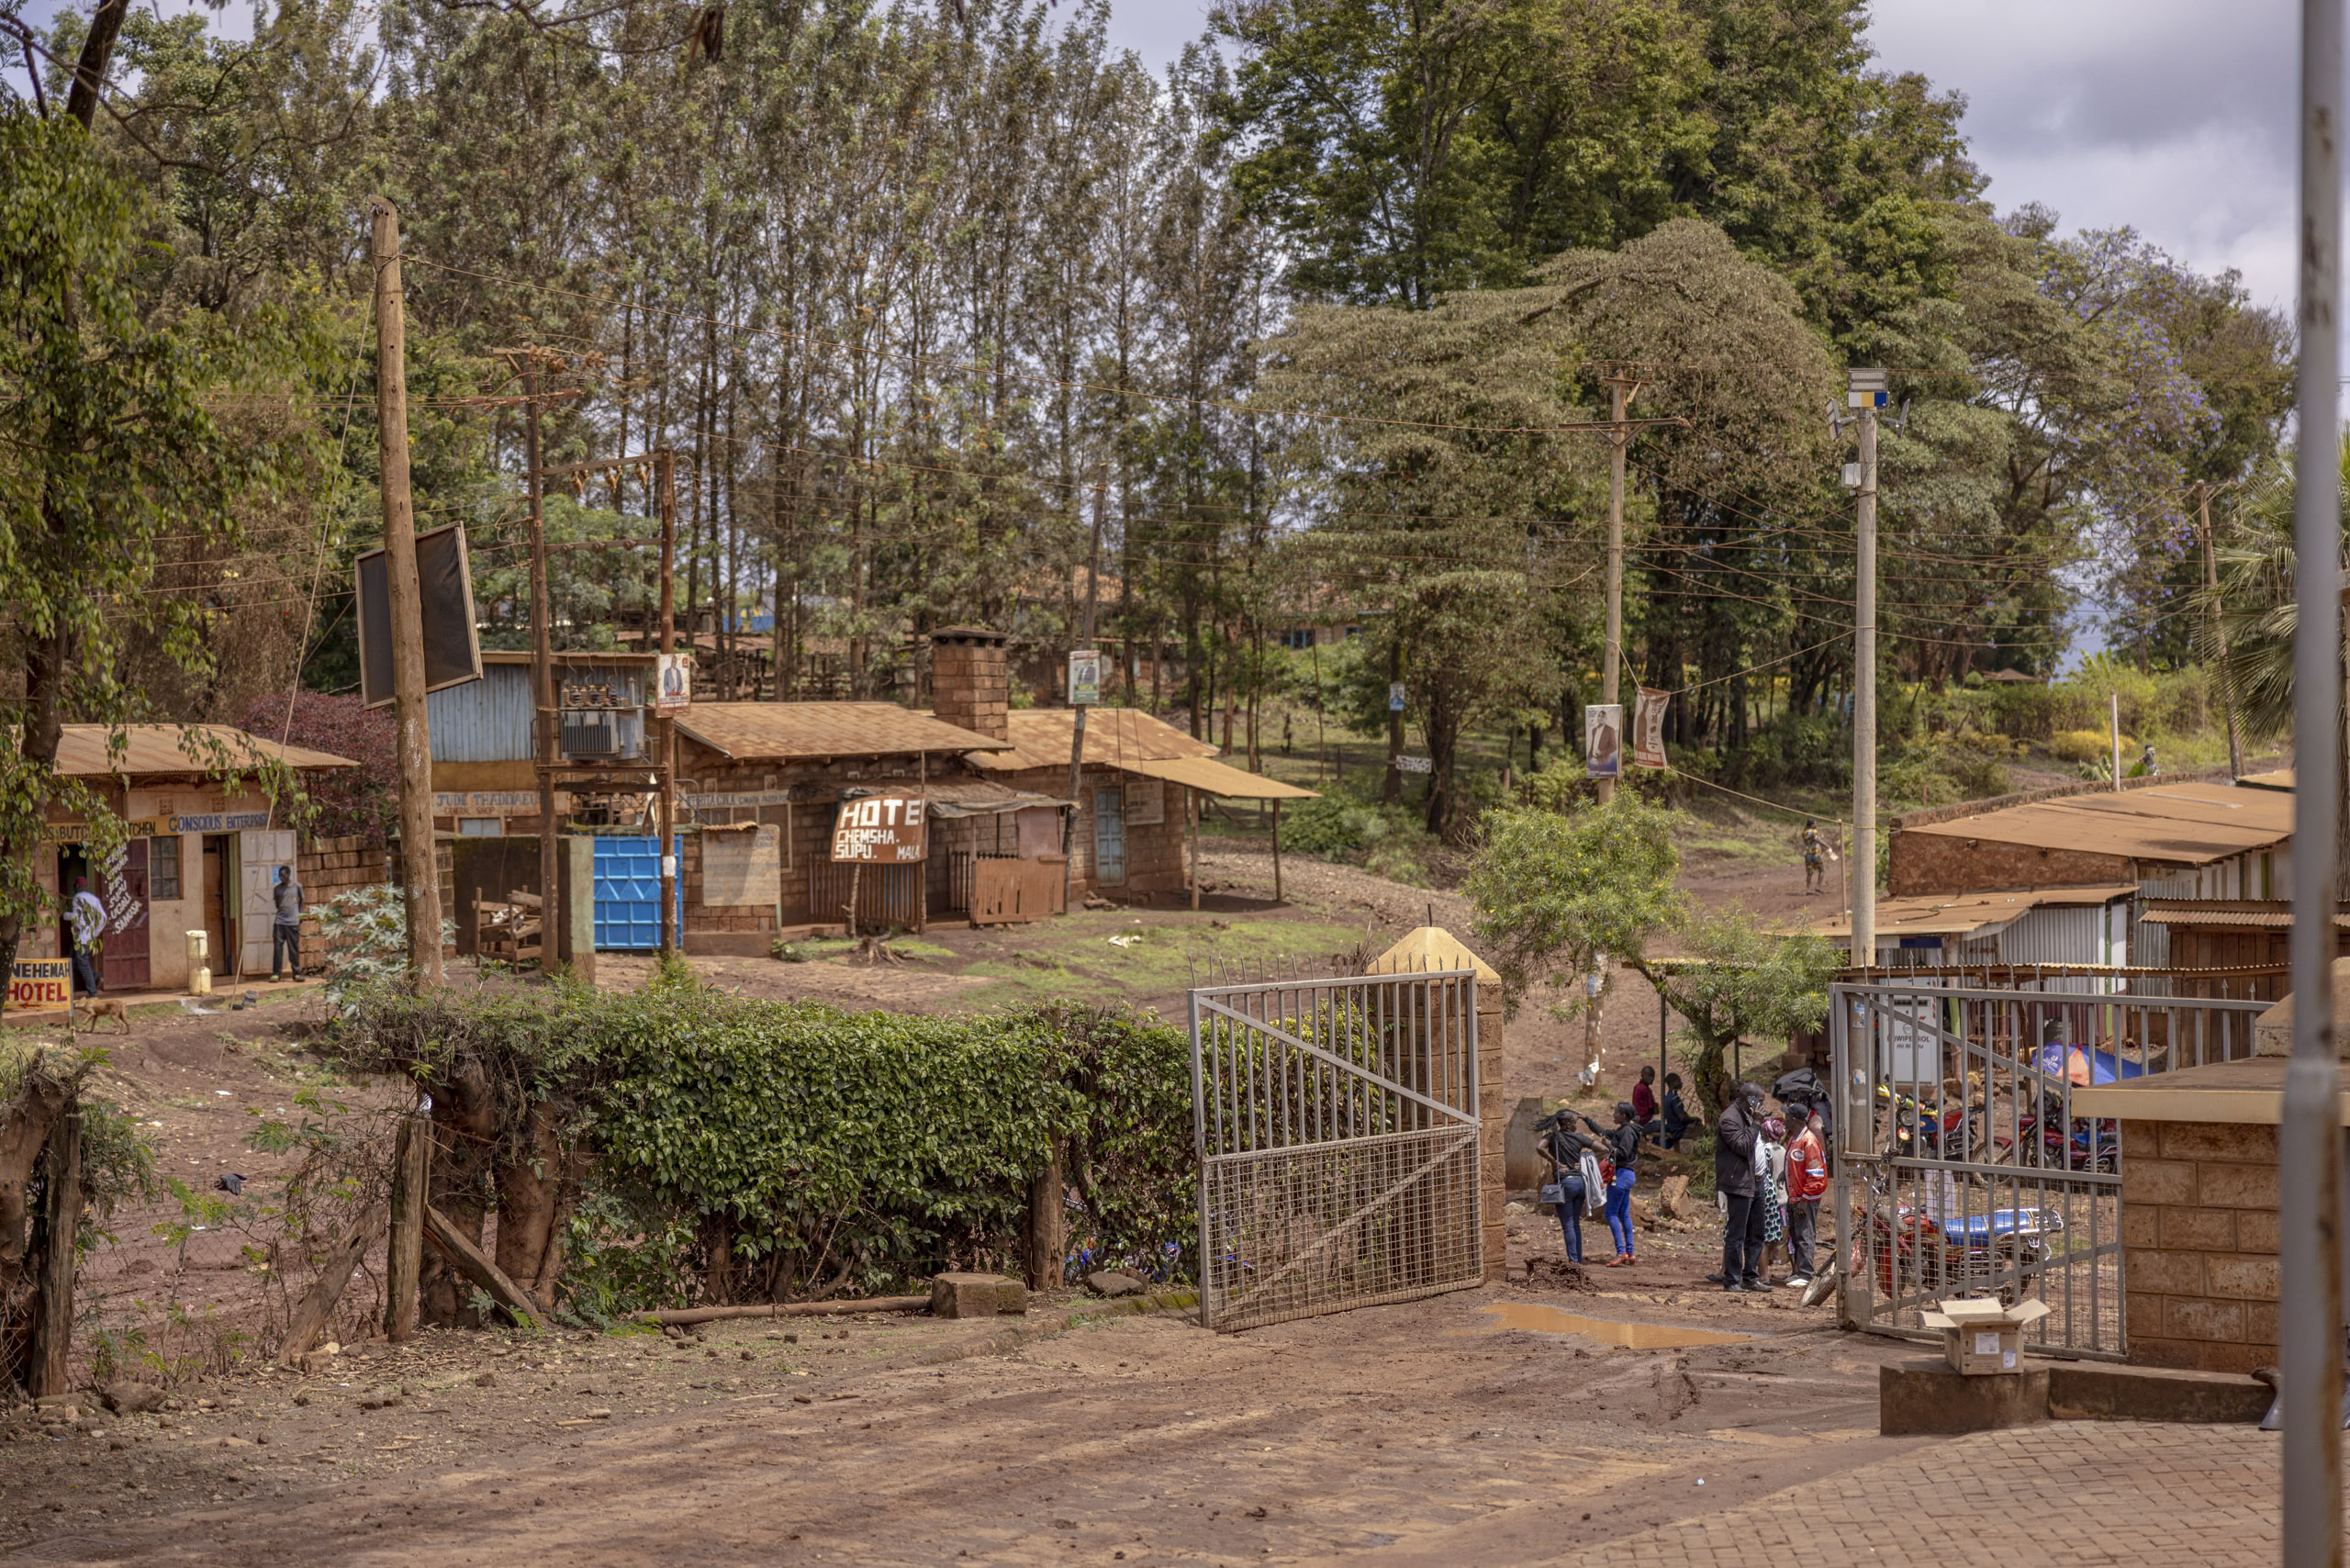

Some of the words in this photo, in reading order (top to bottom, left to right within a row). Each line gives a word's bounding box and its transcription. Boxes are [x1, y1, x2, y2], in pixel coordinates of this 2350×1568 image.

[436, 793, 467, 806] JUDE
[473, 792, 539, 807] THADDAEU
[169, 814, 223, 832] CONSCIOUS
[836, 829, 901, 845] CHEMSHA.
[834, 844, 878, 859] SUPU.
[110, 891, 132, 920] UGALI
[6, 982, 68, 1002] HOTEL
